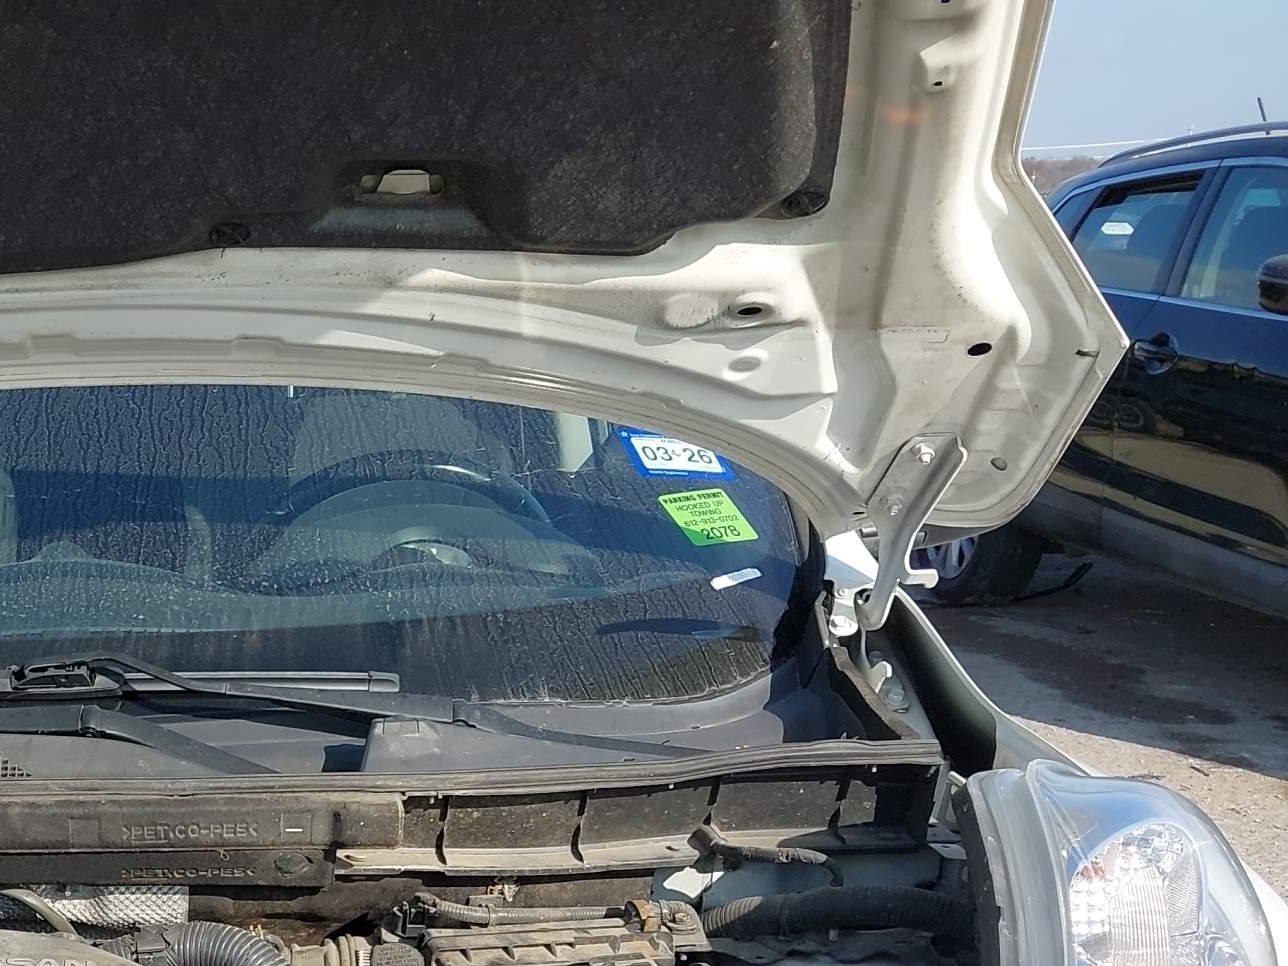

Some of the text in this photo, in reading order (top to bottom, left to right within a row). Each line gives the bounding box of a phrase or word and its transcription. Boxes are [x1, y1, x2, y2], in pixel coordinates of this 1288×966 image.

[641, 445, 713, 465] 03 26
[662, 491, 725, 505] PARKING PERMIT
[675, 500, 724, 512] HOOKED UP
[688, 508, 722, 518] TOWING
[700, 525, 741, 540] 2078
